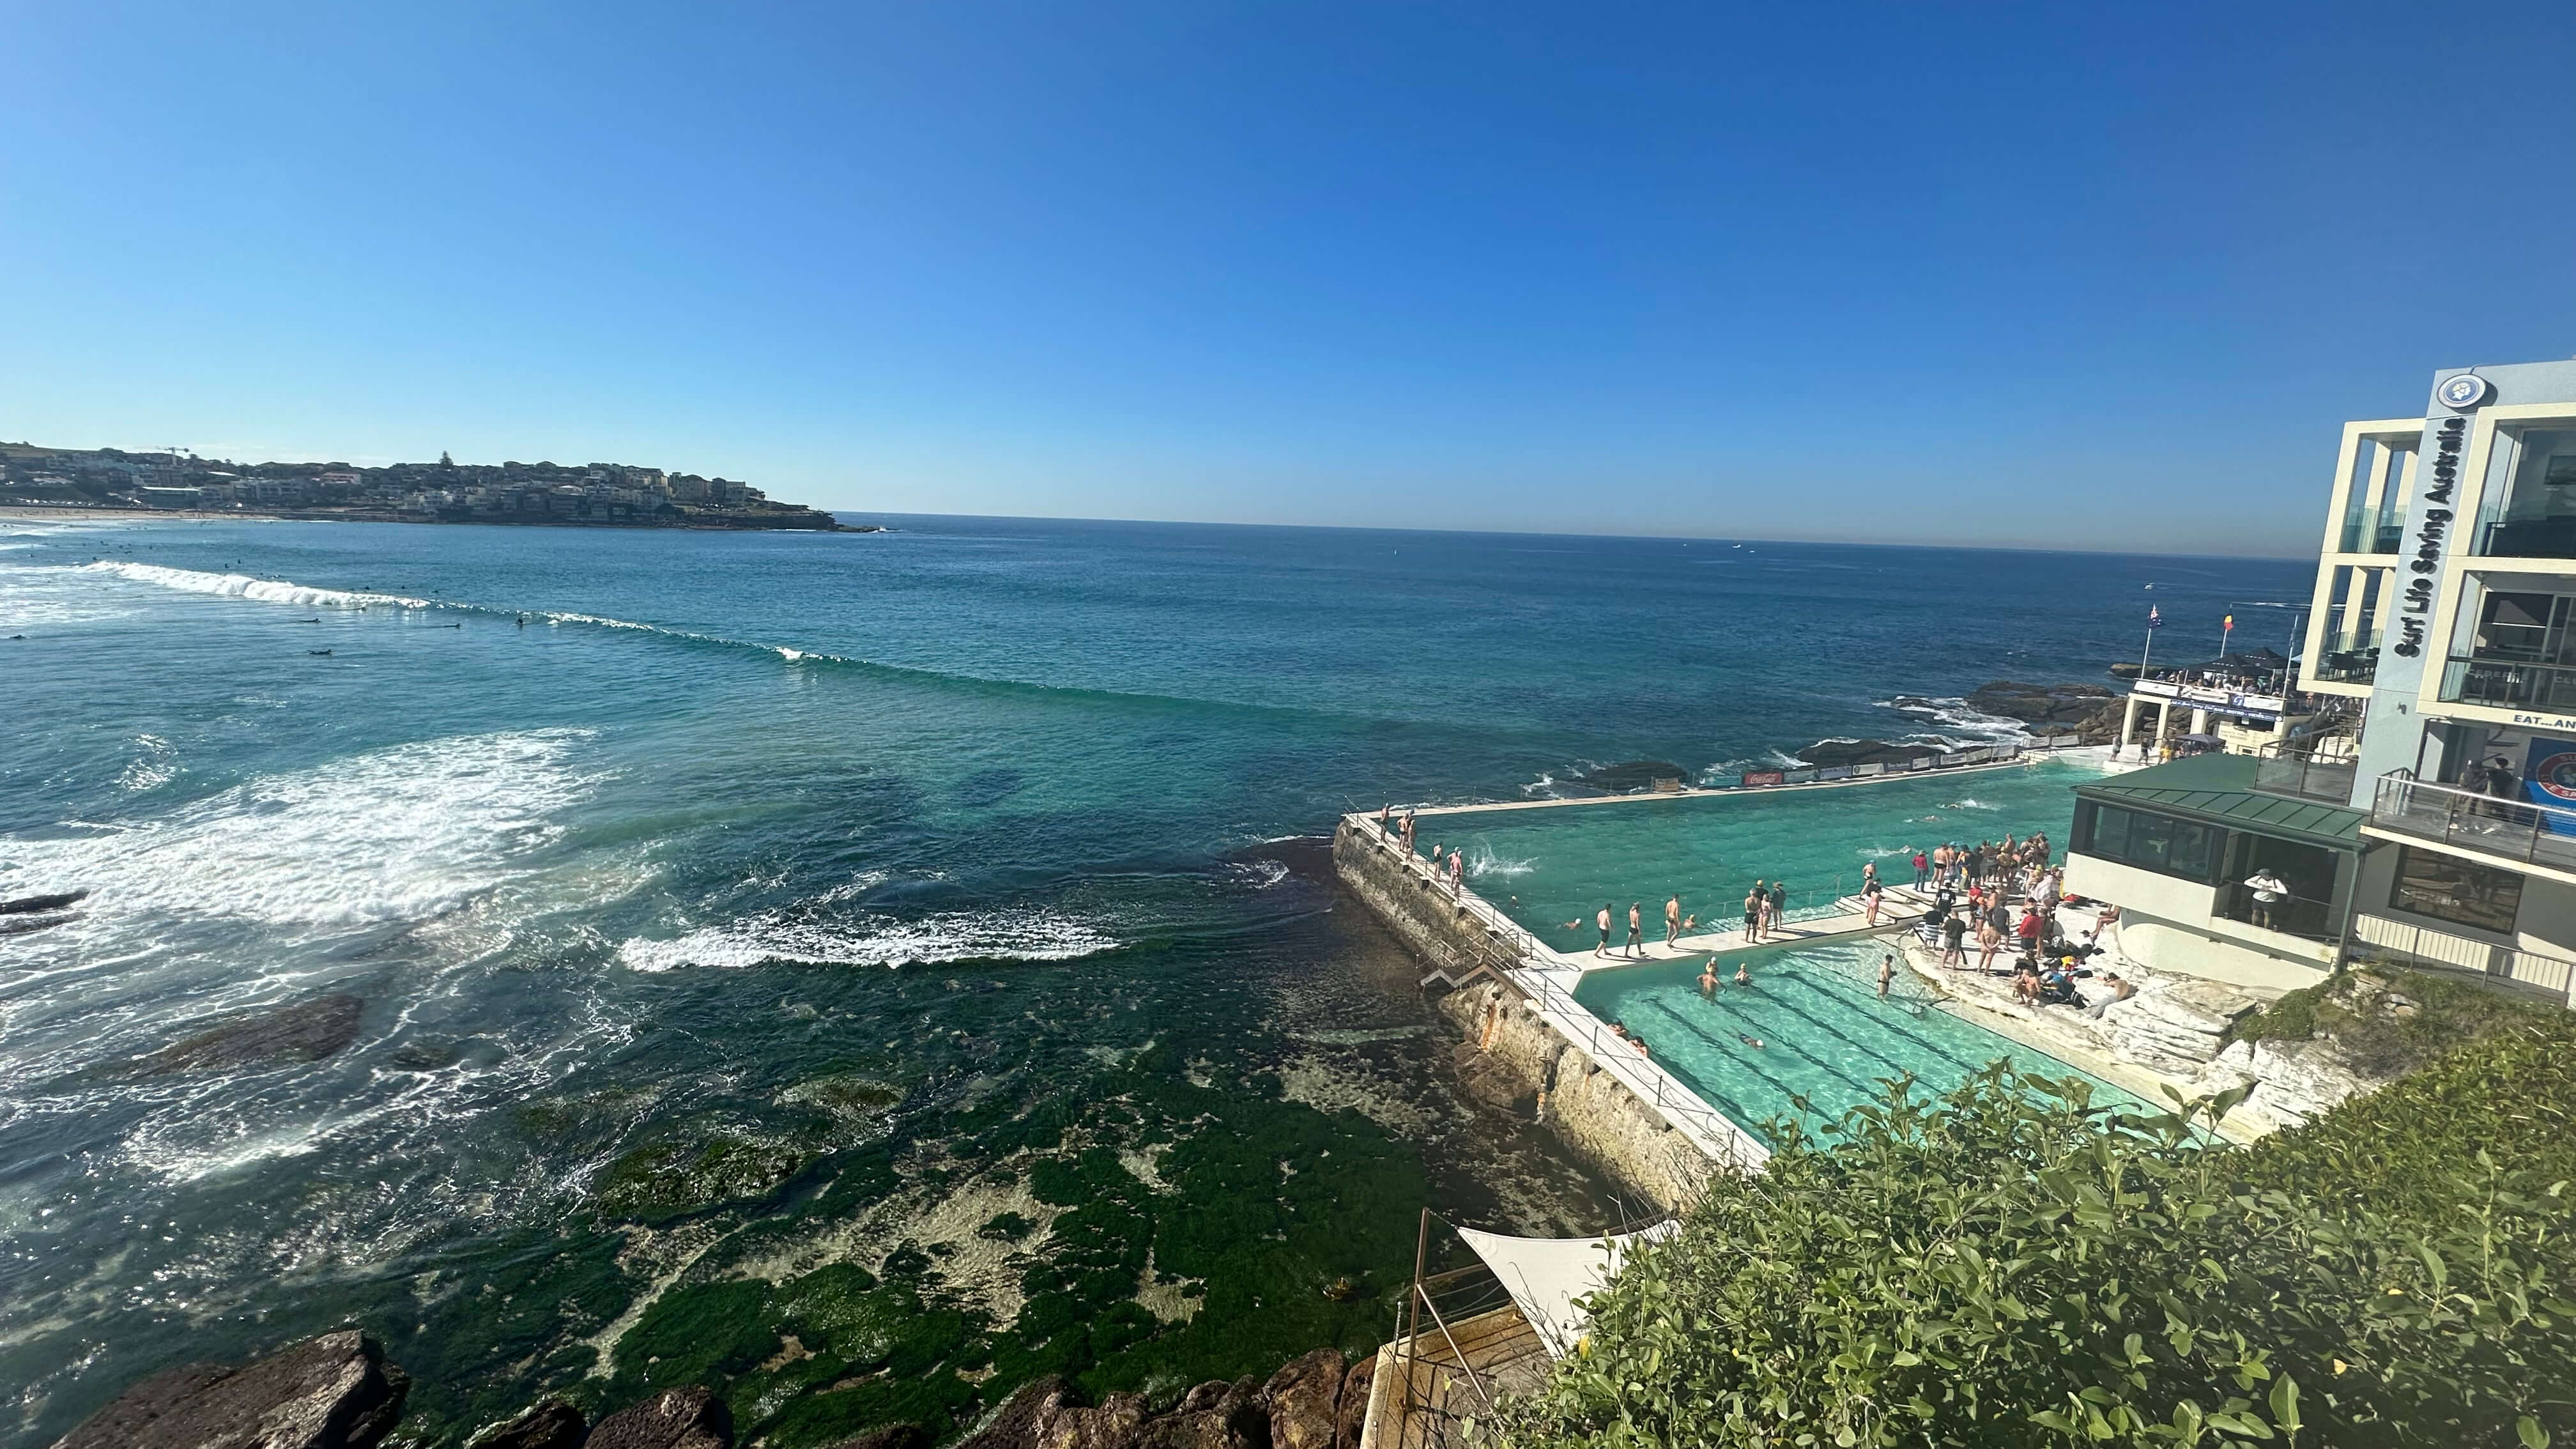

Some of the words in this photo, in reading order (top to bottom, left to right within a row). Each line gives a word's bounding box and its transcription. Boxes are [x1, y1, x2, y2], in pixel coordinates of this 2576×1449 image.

[2425, 418, 2466, 505] Australia
[2411, 509, 2453, 574] Saving
[2402, 578, 2433, 614] Life
[2395, 617, 2426, 658] Surf
